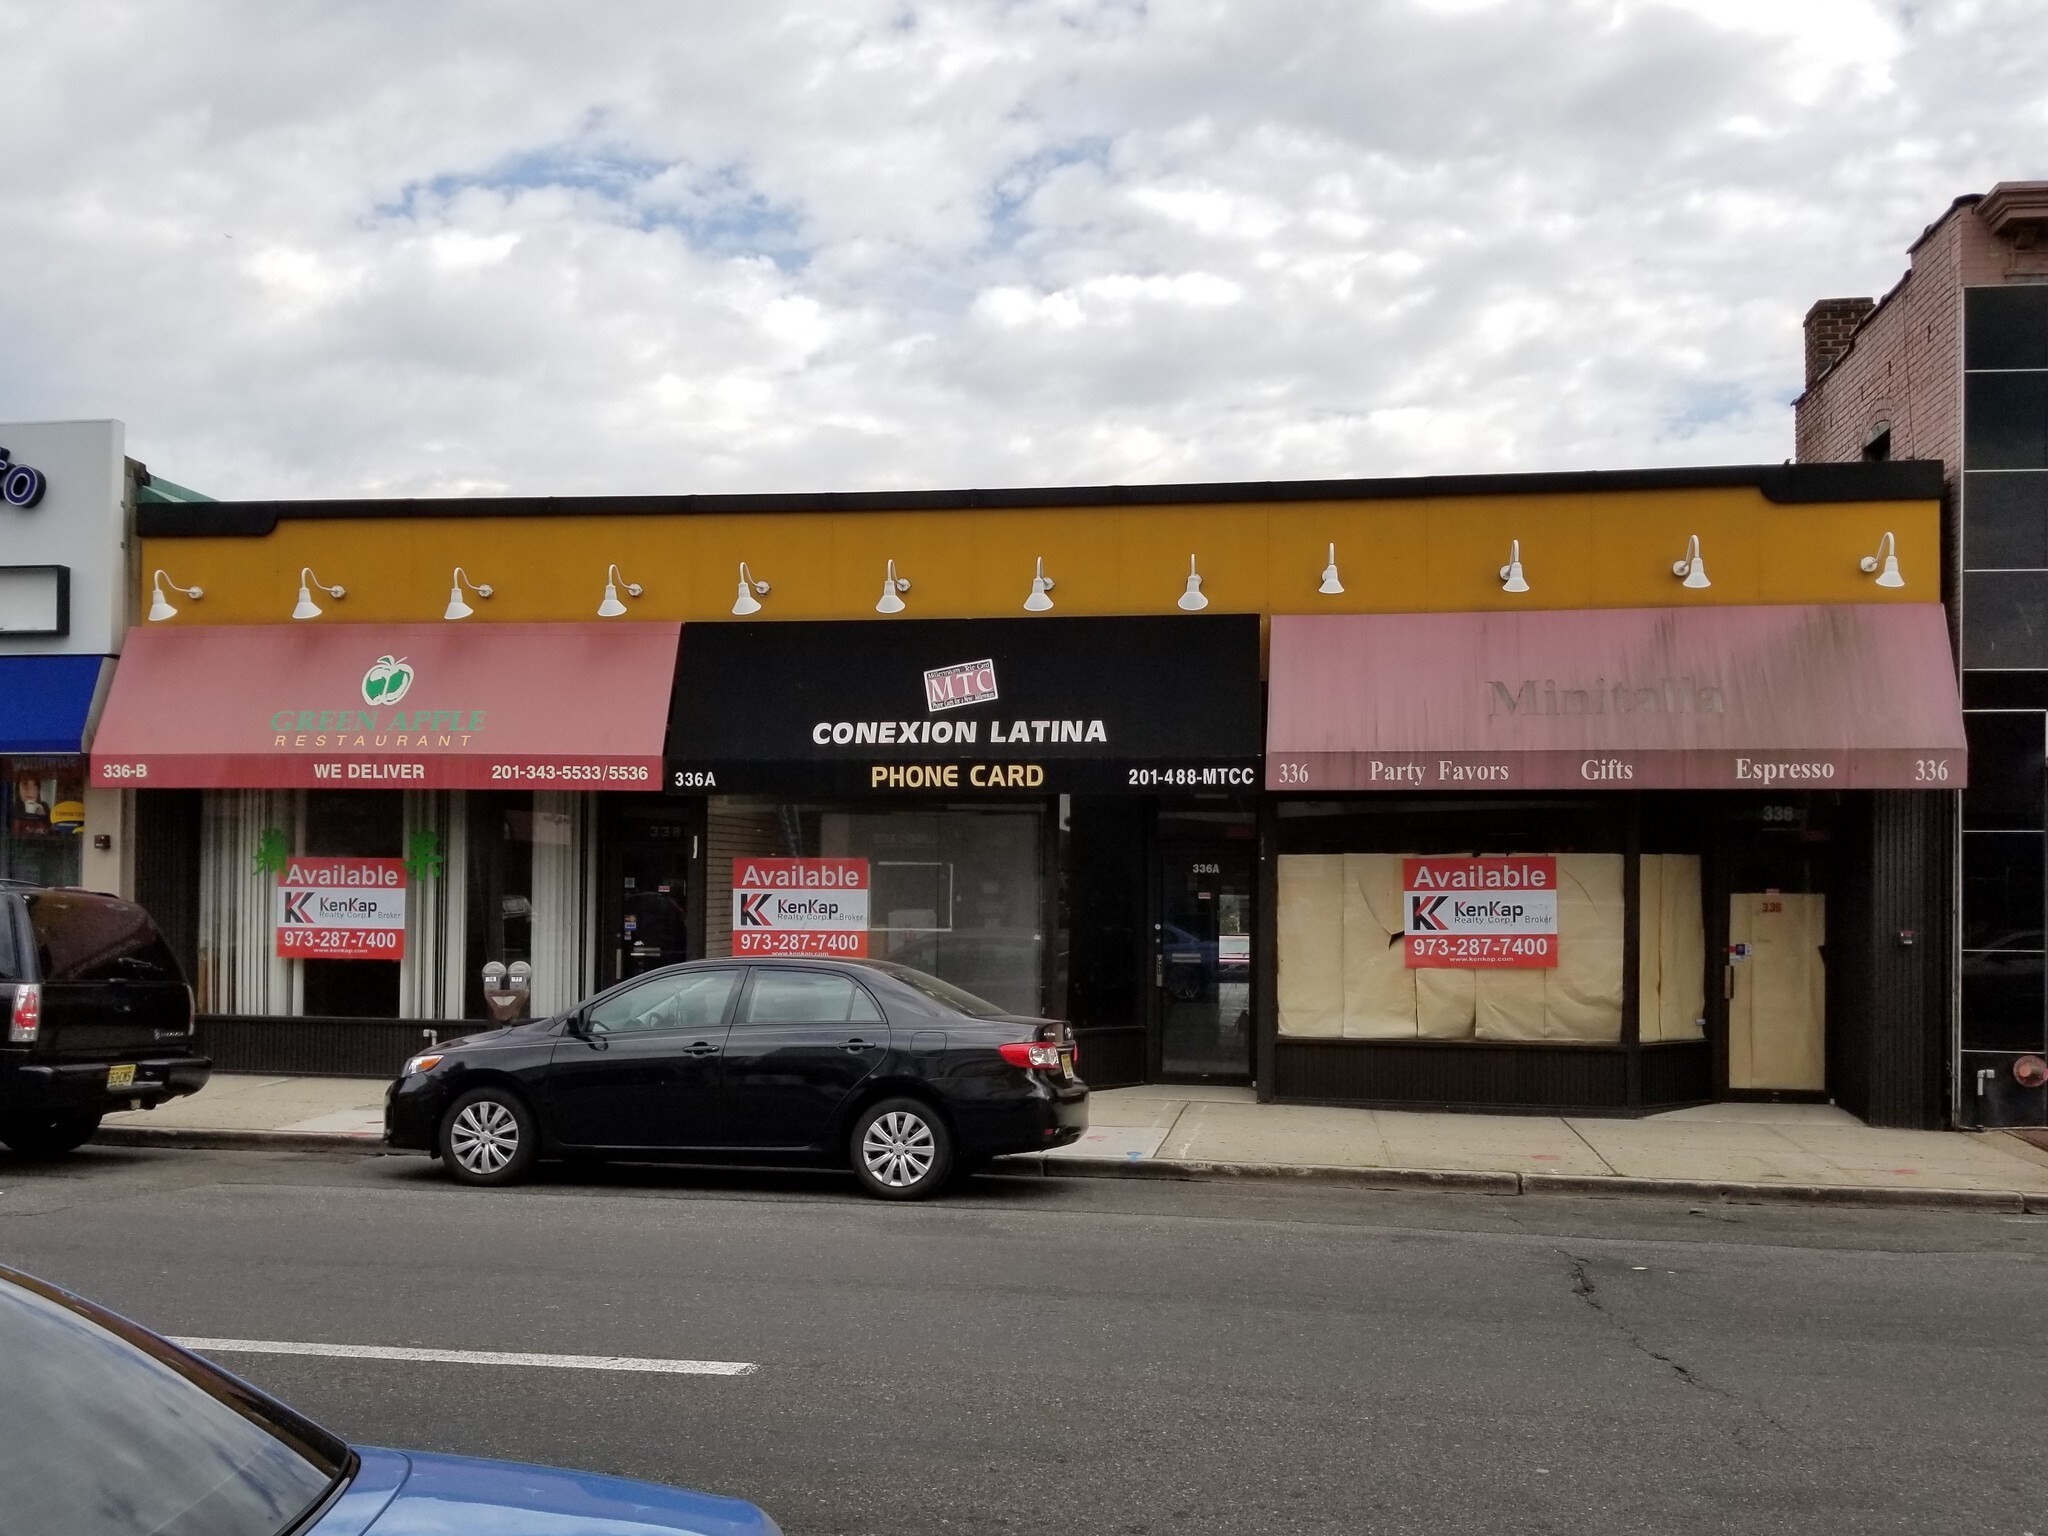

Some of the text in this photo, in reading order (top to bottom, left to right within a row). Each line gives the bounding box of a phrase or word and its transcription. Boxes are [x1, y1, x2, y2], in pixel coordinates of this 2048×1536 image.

[930, 668, 994, 702] MTC
[1485, 678, 1727, 717] Minitalia
[270, 709, 488, 732] GREEN APPLE
[274, 735, 472, 747] RESTAURANT
[812, 720, 1107, 744] CONEXION LATINA
[102, 763, 148, 778] 336-B
[314, 764, 425, 779] WE DELIVER
[491, 765, 649, 781] 201-343-5533/5536
[675, 771, 717, 787] 336A
[871, 765, 1044, 788] PHONE CARD
[1128, 768, 1255, 785] 201-488-MTCC
[1278, 763, 1309, 783] 336
[1369, 760, 1510, 786] Party Favors
[1580, 759, 1634, 780] Gifts
[1735, 758, 1836, 785] Espresso
[1914, 760, 1949, 781] 336
[1762, 806, 1794, 821] 336
[286, 864, 399, 886] Available
[741, 865, 859, 886] Available
[1192, 864, 1220, 874] 336A
[1413, 864, 1547, 888] Available
[319, 898, 378, 917] KenKap
[319, 911, 345, 919] Realty
[378, 911, 401, 919] Broker
[777, 899, 839, 920] KenKap
[777, 913, 804, 921] Realty
[839, 913, 864, 921] Broker
[1454, 901, 1524, 923] KenKap
[1454, 916, 1484, 924] Realty
[1524, 915, 1552, 924] Broker
[284, 931, 397, 948] 973-287-7400
[741, 933, 859, 950] 973-287-7400
[1413, 938, 1548, 956] 973-287-7400
